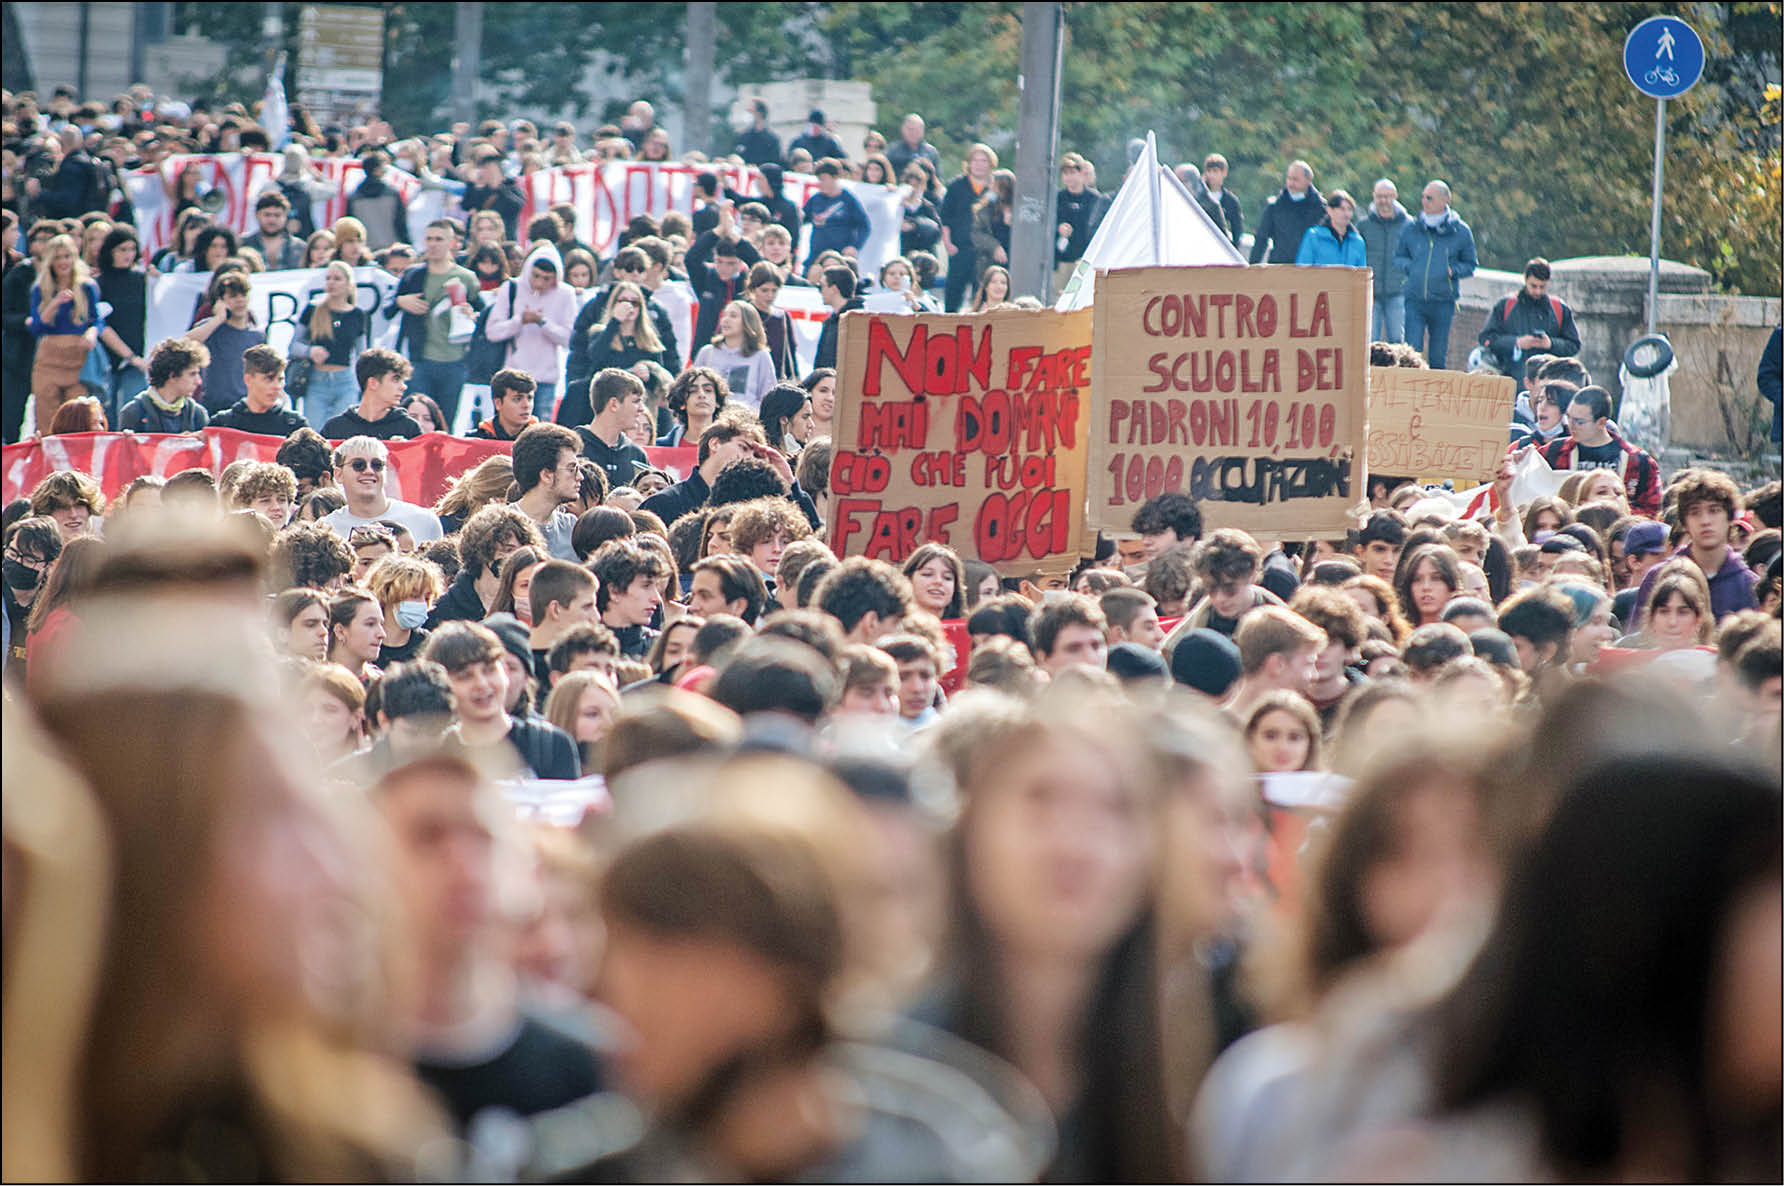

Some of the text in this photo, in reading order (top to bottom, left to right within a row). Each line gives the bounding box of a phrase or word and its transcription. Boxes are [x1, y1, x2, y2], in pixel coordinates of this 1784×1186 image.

[1143, 291, 1333, 338] CONTRO LA
[862, 317, 1092, 396] NON FARE
[1143, 348, 1343, 393] SCUOLA DEI
[1108, 399, 1239, 446] PADRONI
[911, 452, 967, 487] CHE
[1108, 452, 1184, 505] 1000
[830, 488, 1070, 563] FARE OGGI
